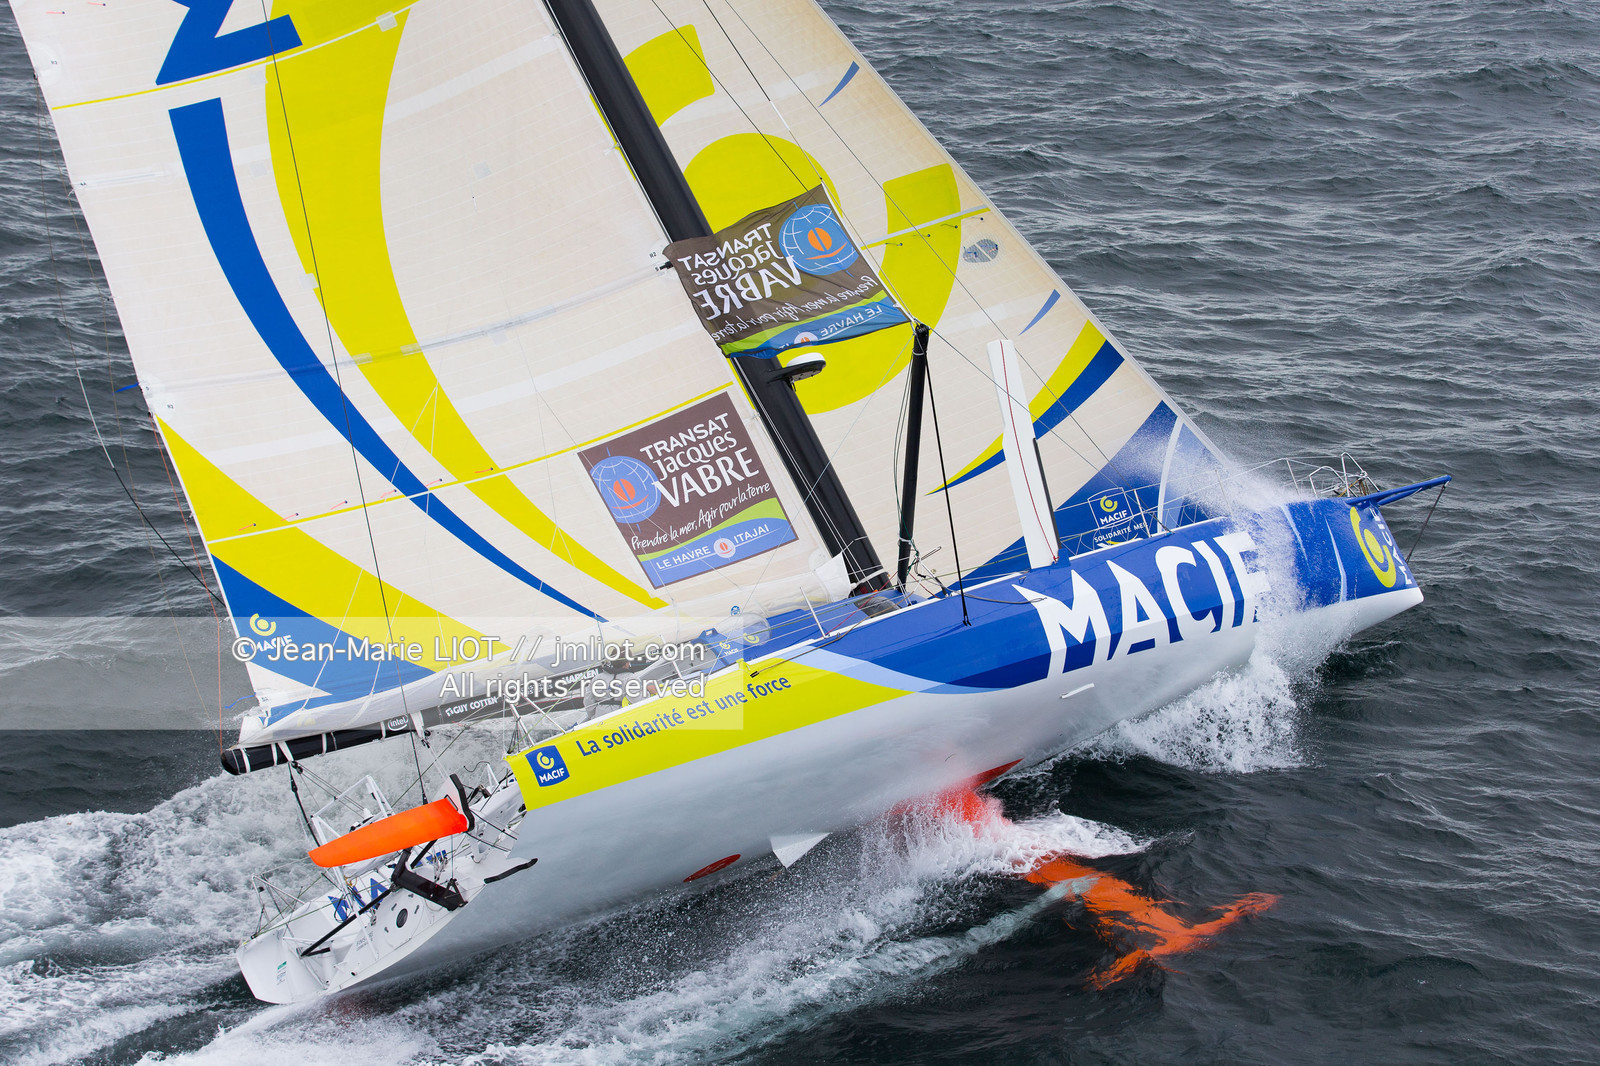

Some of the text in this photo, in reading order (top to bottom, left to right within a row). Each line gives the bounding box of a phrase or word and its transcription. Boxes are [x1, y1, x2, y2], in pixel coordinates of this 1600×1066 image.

[640, 412, 729, 461] TRANSAT
[651, 447, 760, 508] VABRE
[631, 482, 771, 550] Prendre la mer, Agir pour la terre
[1100, 510, 1128, 525] MACIF
[655, 523, 770, 570] LE HAVRE ITAJAI
[1369, 505, 1413, 585] MACIF
[1012, 531, 1272, 680] MACIF
[388, 714, 409, 729] intel
[453, 696, 498, 714] GUY COTTEN
[576, 677, 792, 757] La solidarité est une force
[539, 767, 565, 783] MACIF
